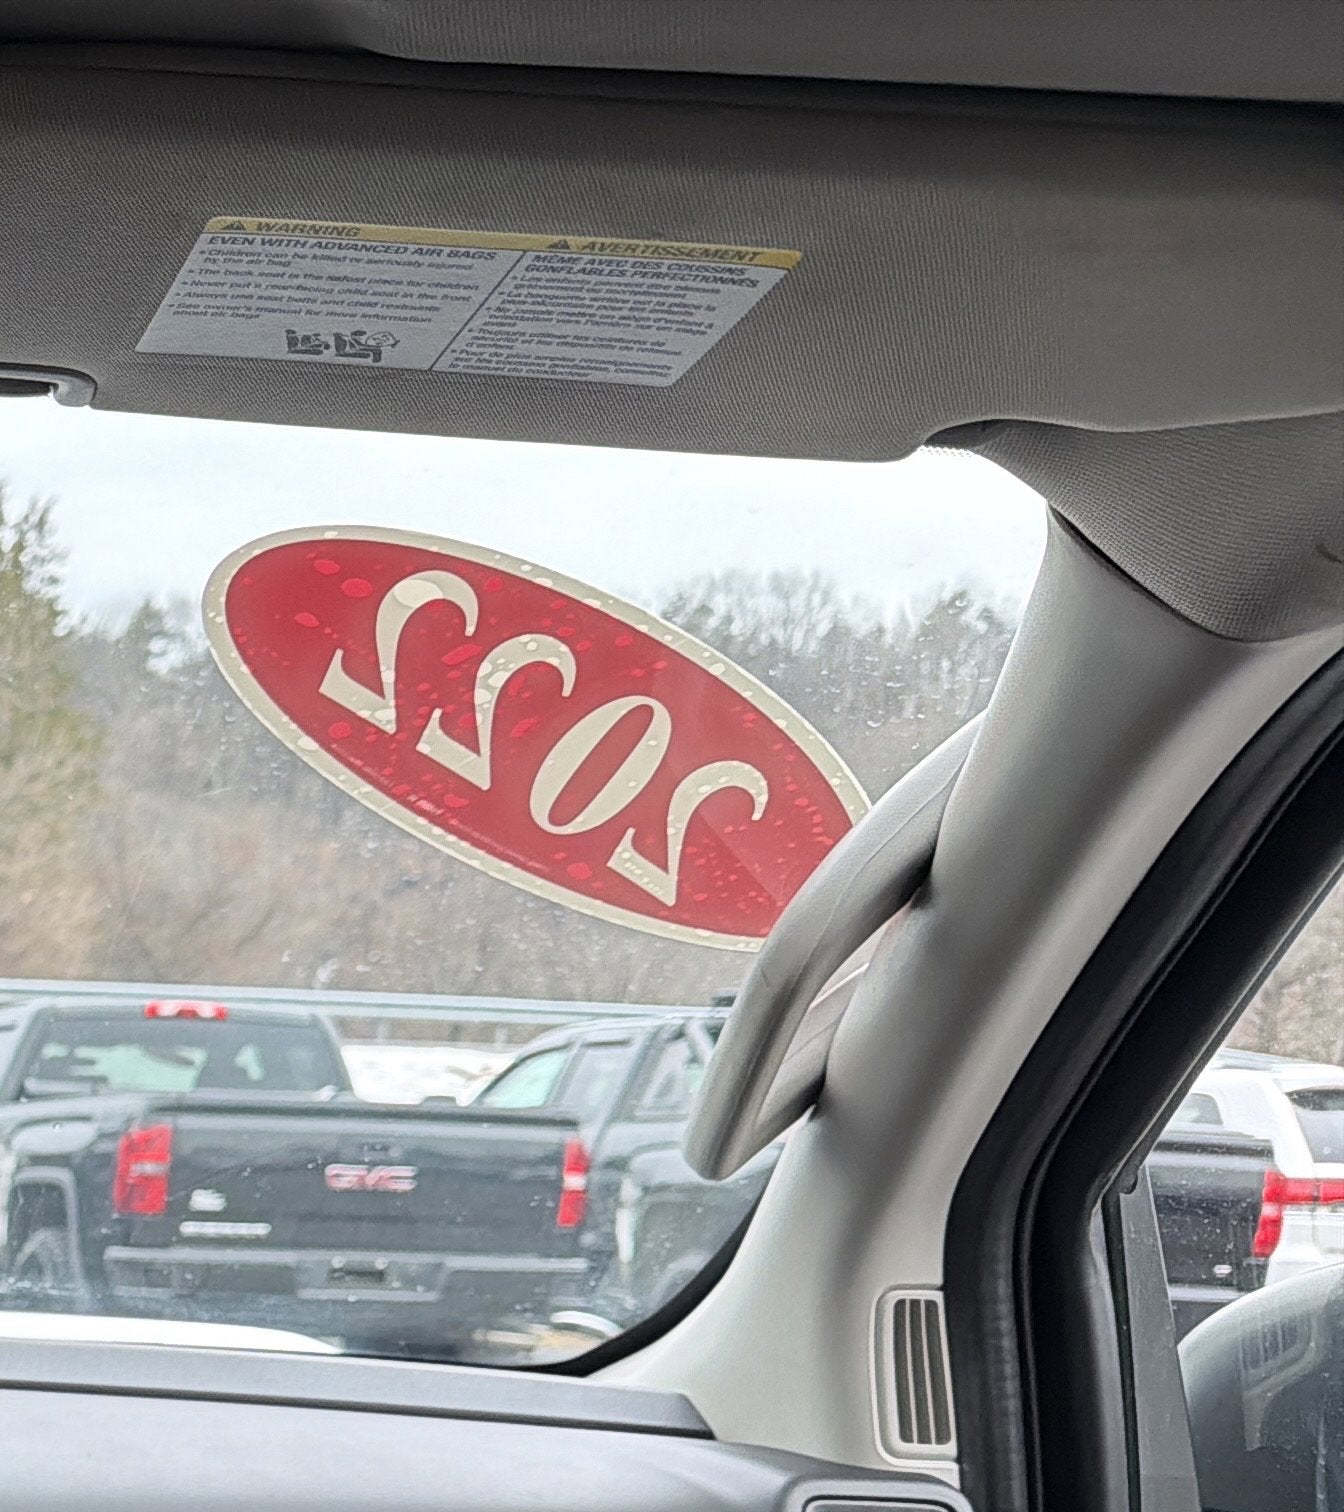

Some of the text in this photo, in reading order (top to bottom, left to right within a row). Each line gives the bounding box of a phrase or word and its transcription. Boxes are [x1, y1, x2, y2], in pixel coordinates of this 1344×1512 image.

[257, 222, 361, 237] WARNING
[208, 236, 497, 261] EVEN WITH ADVANCED AIR BAGS
[631, 260, 664, 270] DES
